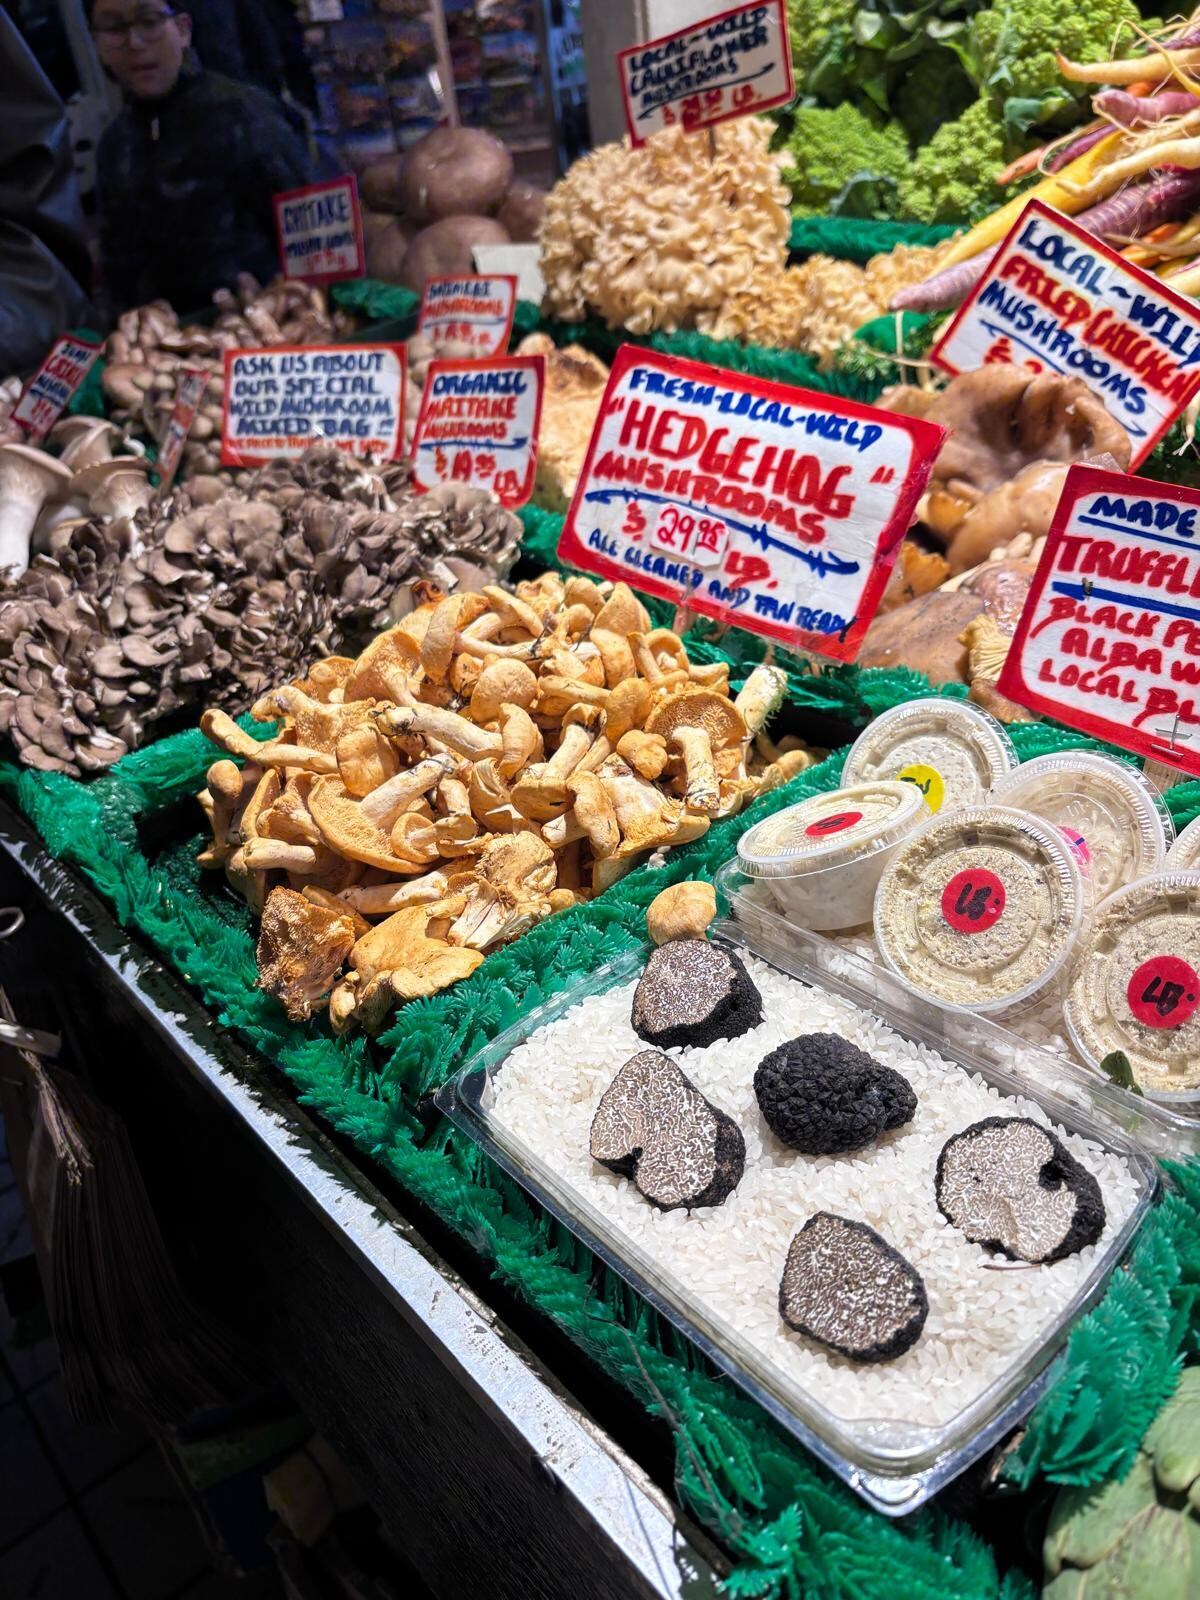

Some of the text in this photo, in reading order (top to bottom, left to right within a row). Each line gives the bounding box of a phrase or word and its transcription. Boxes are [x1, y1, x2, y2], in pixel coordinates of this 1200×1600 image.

[1000, 254, 1091, 331] FRIED
[234, 353, 384, 376] ASK US ABOUT
[977, 279, 1147, 415] MUSHROOMS
[1082, 309, 1200, 402] CHICKEN
[234, 376, 382, 396] OUR SPECIAL
[432, 371, 527, 395] ORGANIC
[230, 399, 278, 416] WILD
[237, 418, 370, 437] MIXED BAG
[425, 396, 518, 421] MAITAKE
[592, 450, 828, 544] MUSHROOMS
[1088, 495, 1198, 538] MADE
[589, 527, 618, 556] ALL
[624, 546, 704, 590] CLEANED
[708, 579, 750, 609] AND
[796, 606, 858, 643] READY
[1030, 596, 1161, 639] BLACK
[1060, 627, 1163, 676] ALBA
[1038, 658, 1139, 703] LOCAL
